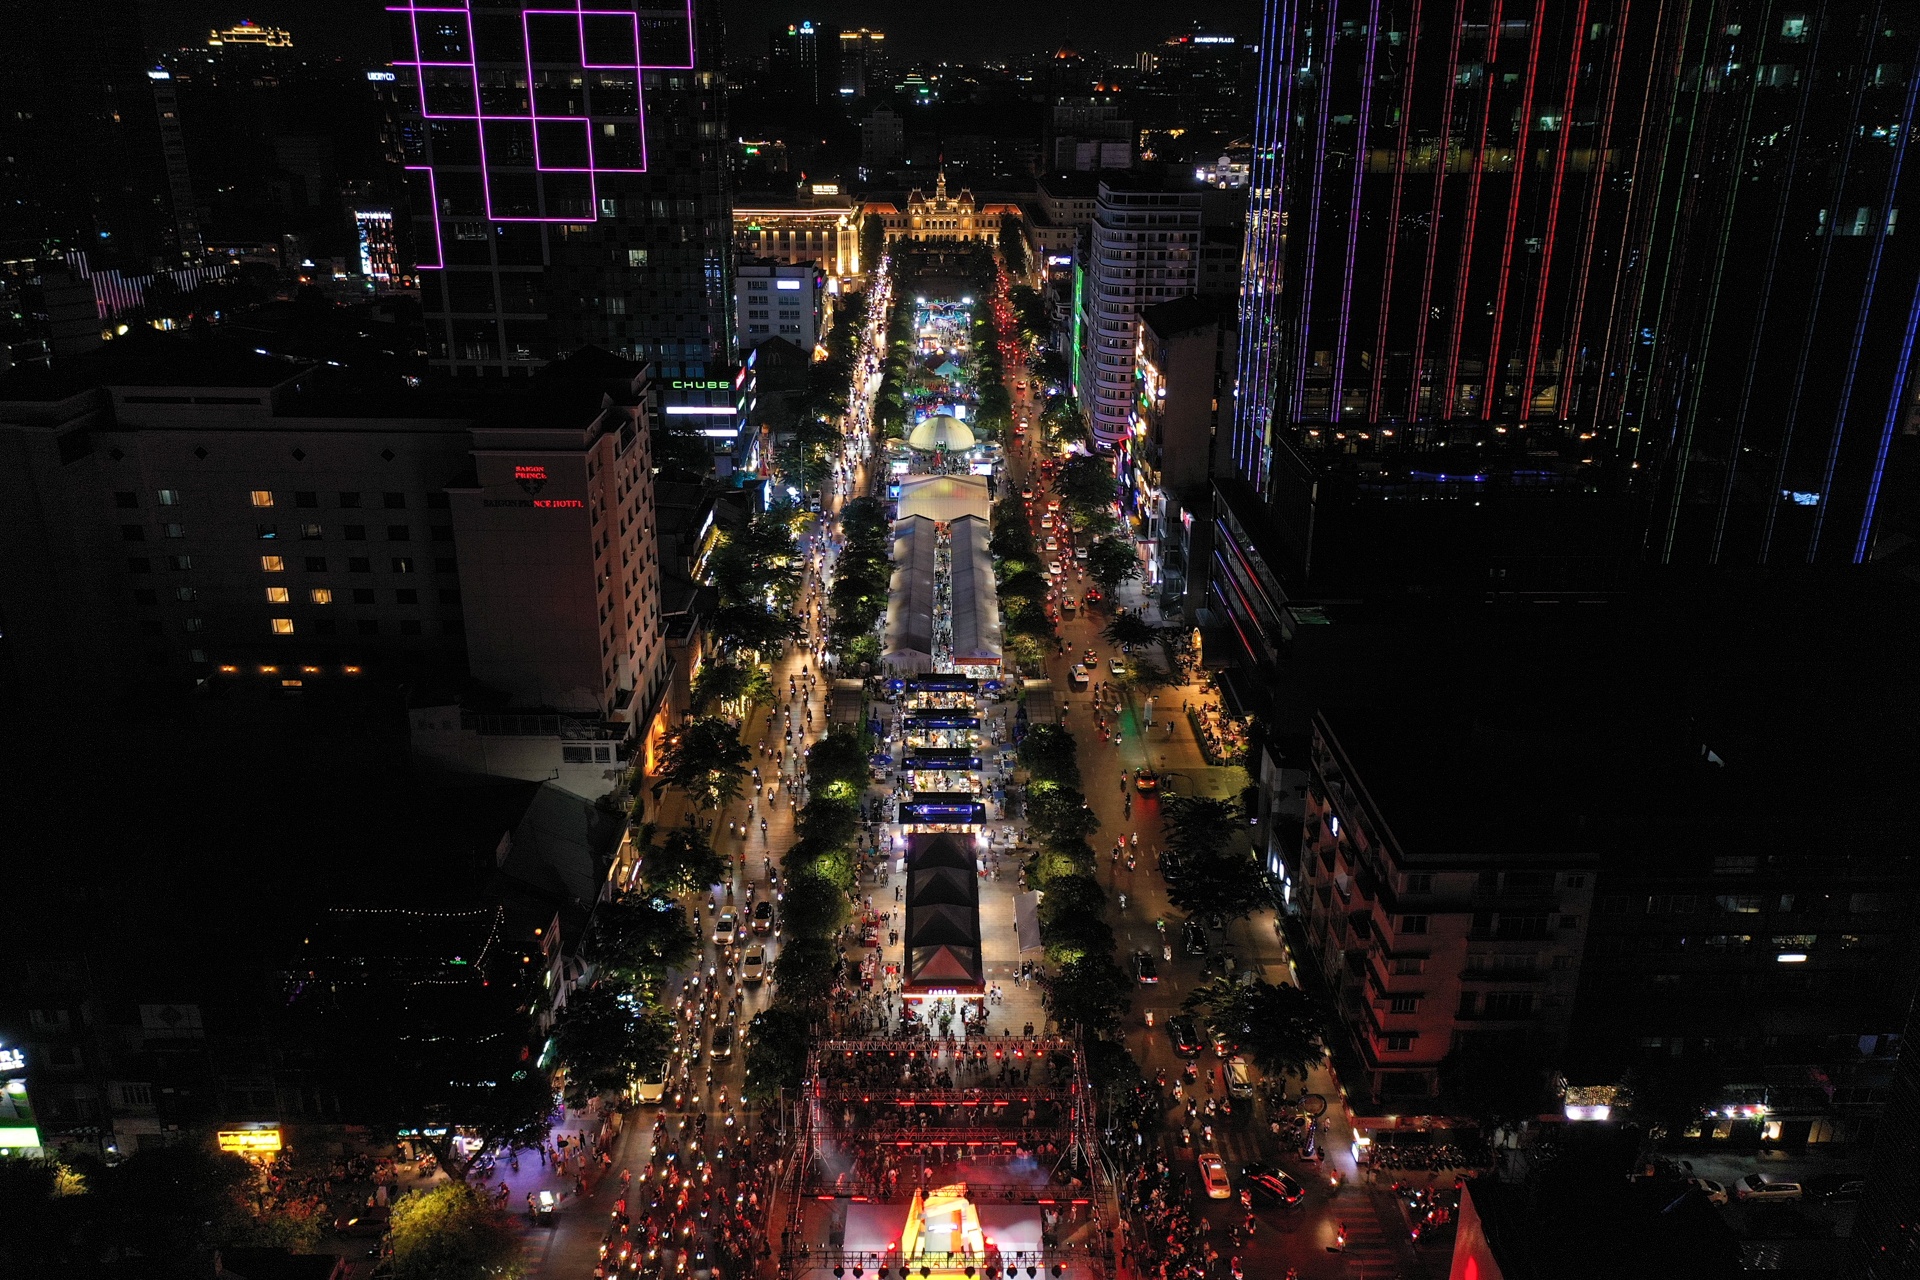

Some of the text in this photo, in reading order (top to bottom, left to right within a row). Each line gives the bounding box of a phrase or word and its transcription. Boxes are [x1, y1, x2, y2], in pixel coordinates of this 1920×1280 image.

[672, 381, 730, 389] CHUBB
[483, 500, 517, 508] SAIGON
[553, 500, 584, 508] HOTEL
